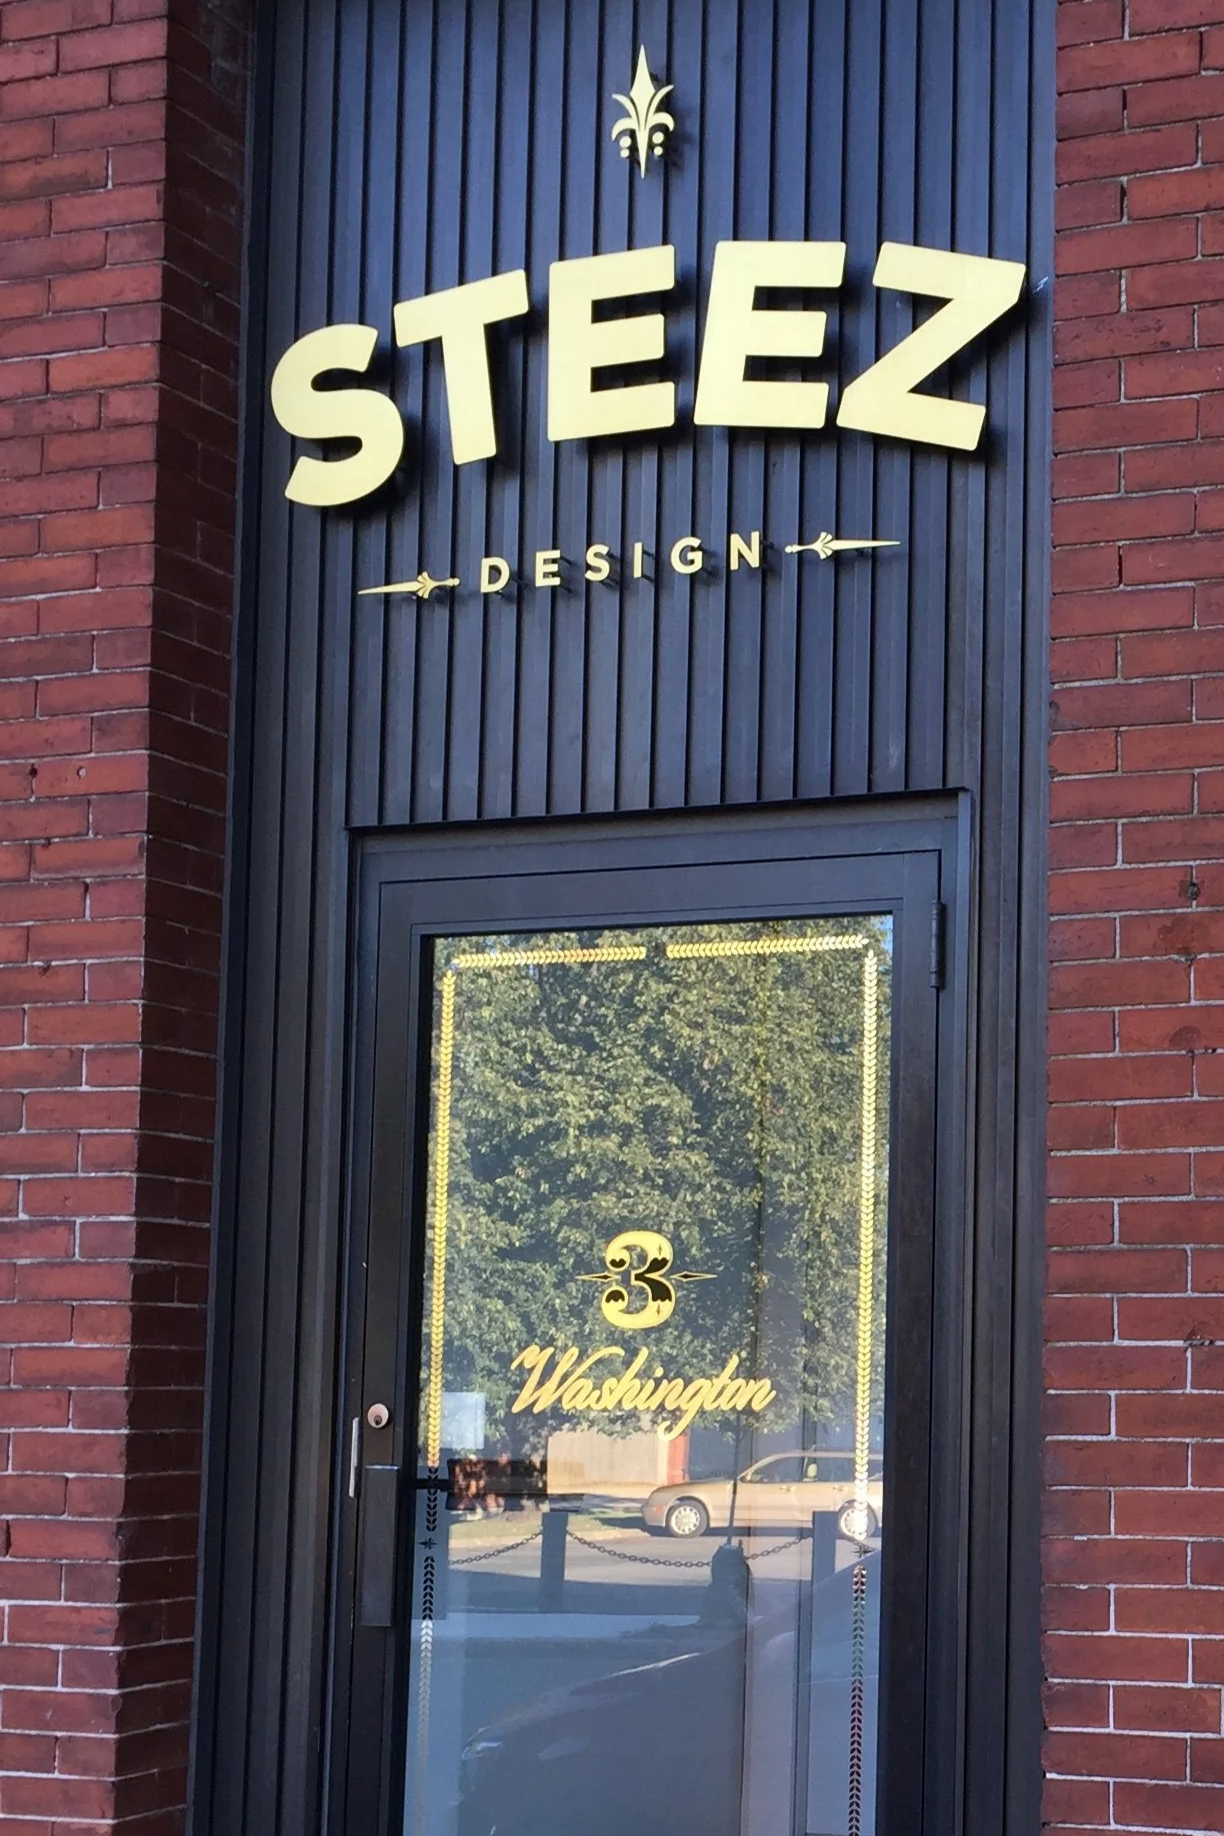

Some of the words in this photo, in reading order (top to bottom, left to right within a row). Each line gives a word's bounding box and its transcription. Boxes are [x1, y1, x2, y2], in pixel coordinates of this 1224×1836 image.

[271, 241, 1026, 507] STEEZ
[479, 531, 761, 593] DESIGN
[600, 1230, 676, 1329] 3
[510, 1345, 776, 1441] Washington
